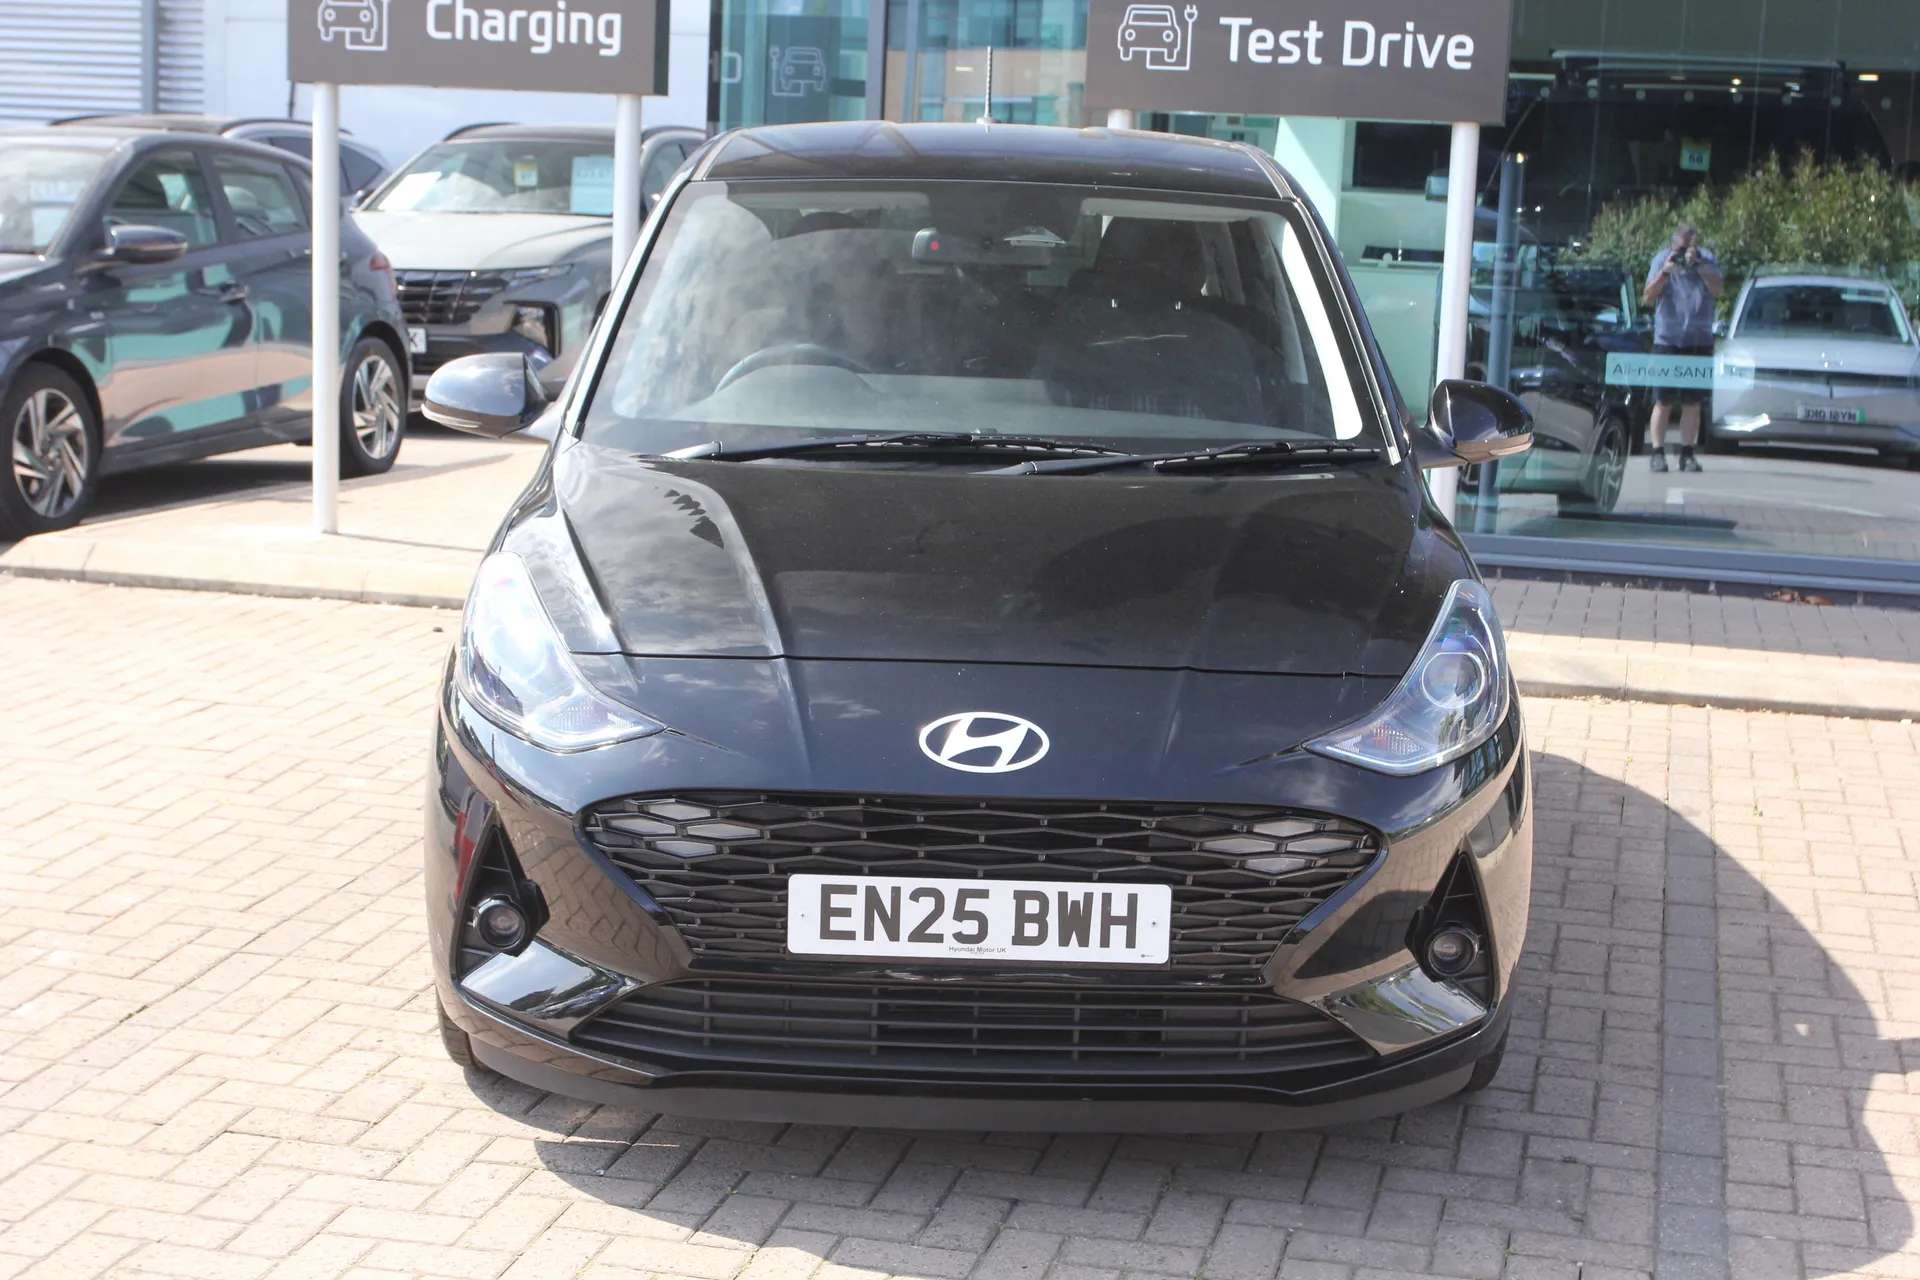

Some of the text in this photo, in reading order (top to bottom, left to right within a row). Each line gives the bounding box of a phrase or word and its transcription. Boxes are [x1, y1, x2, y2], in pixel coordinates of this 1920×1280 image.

[426, 0, 622, 56] Charging
[1219, 17, 1474, 70] Test Drive
[1612, 362, 1669, 377] All-new
[1673, 365, 1717, 380] SANT
[819, 883, 1139, 949] EN25 BWH
